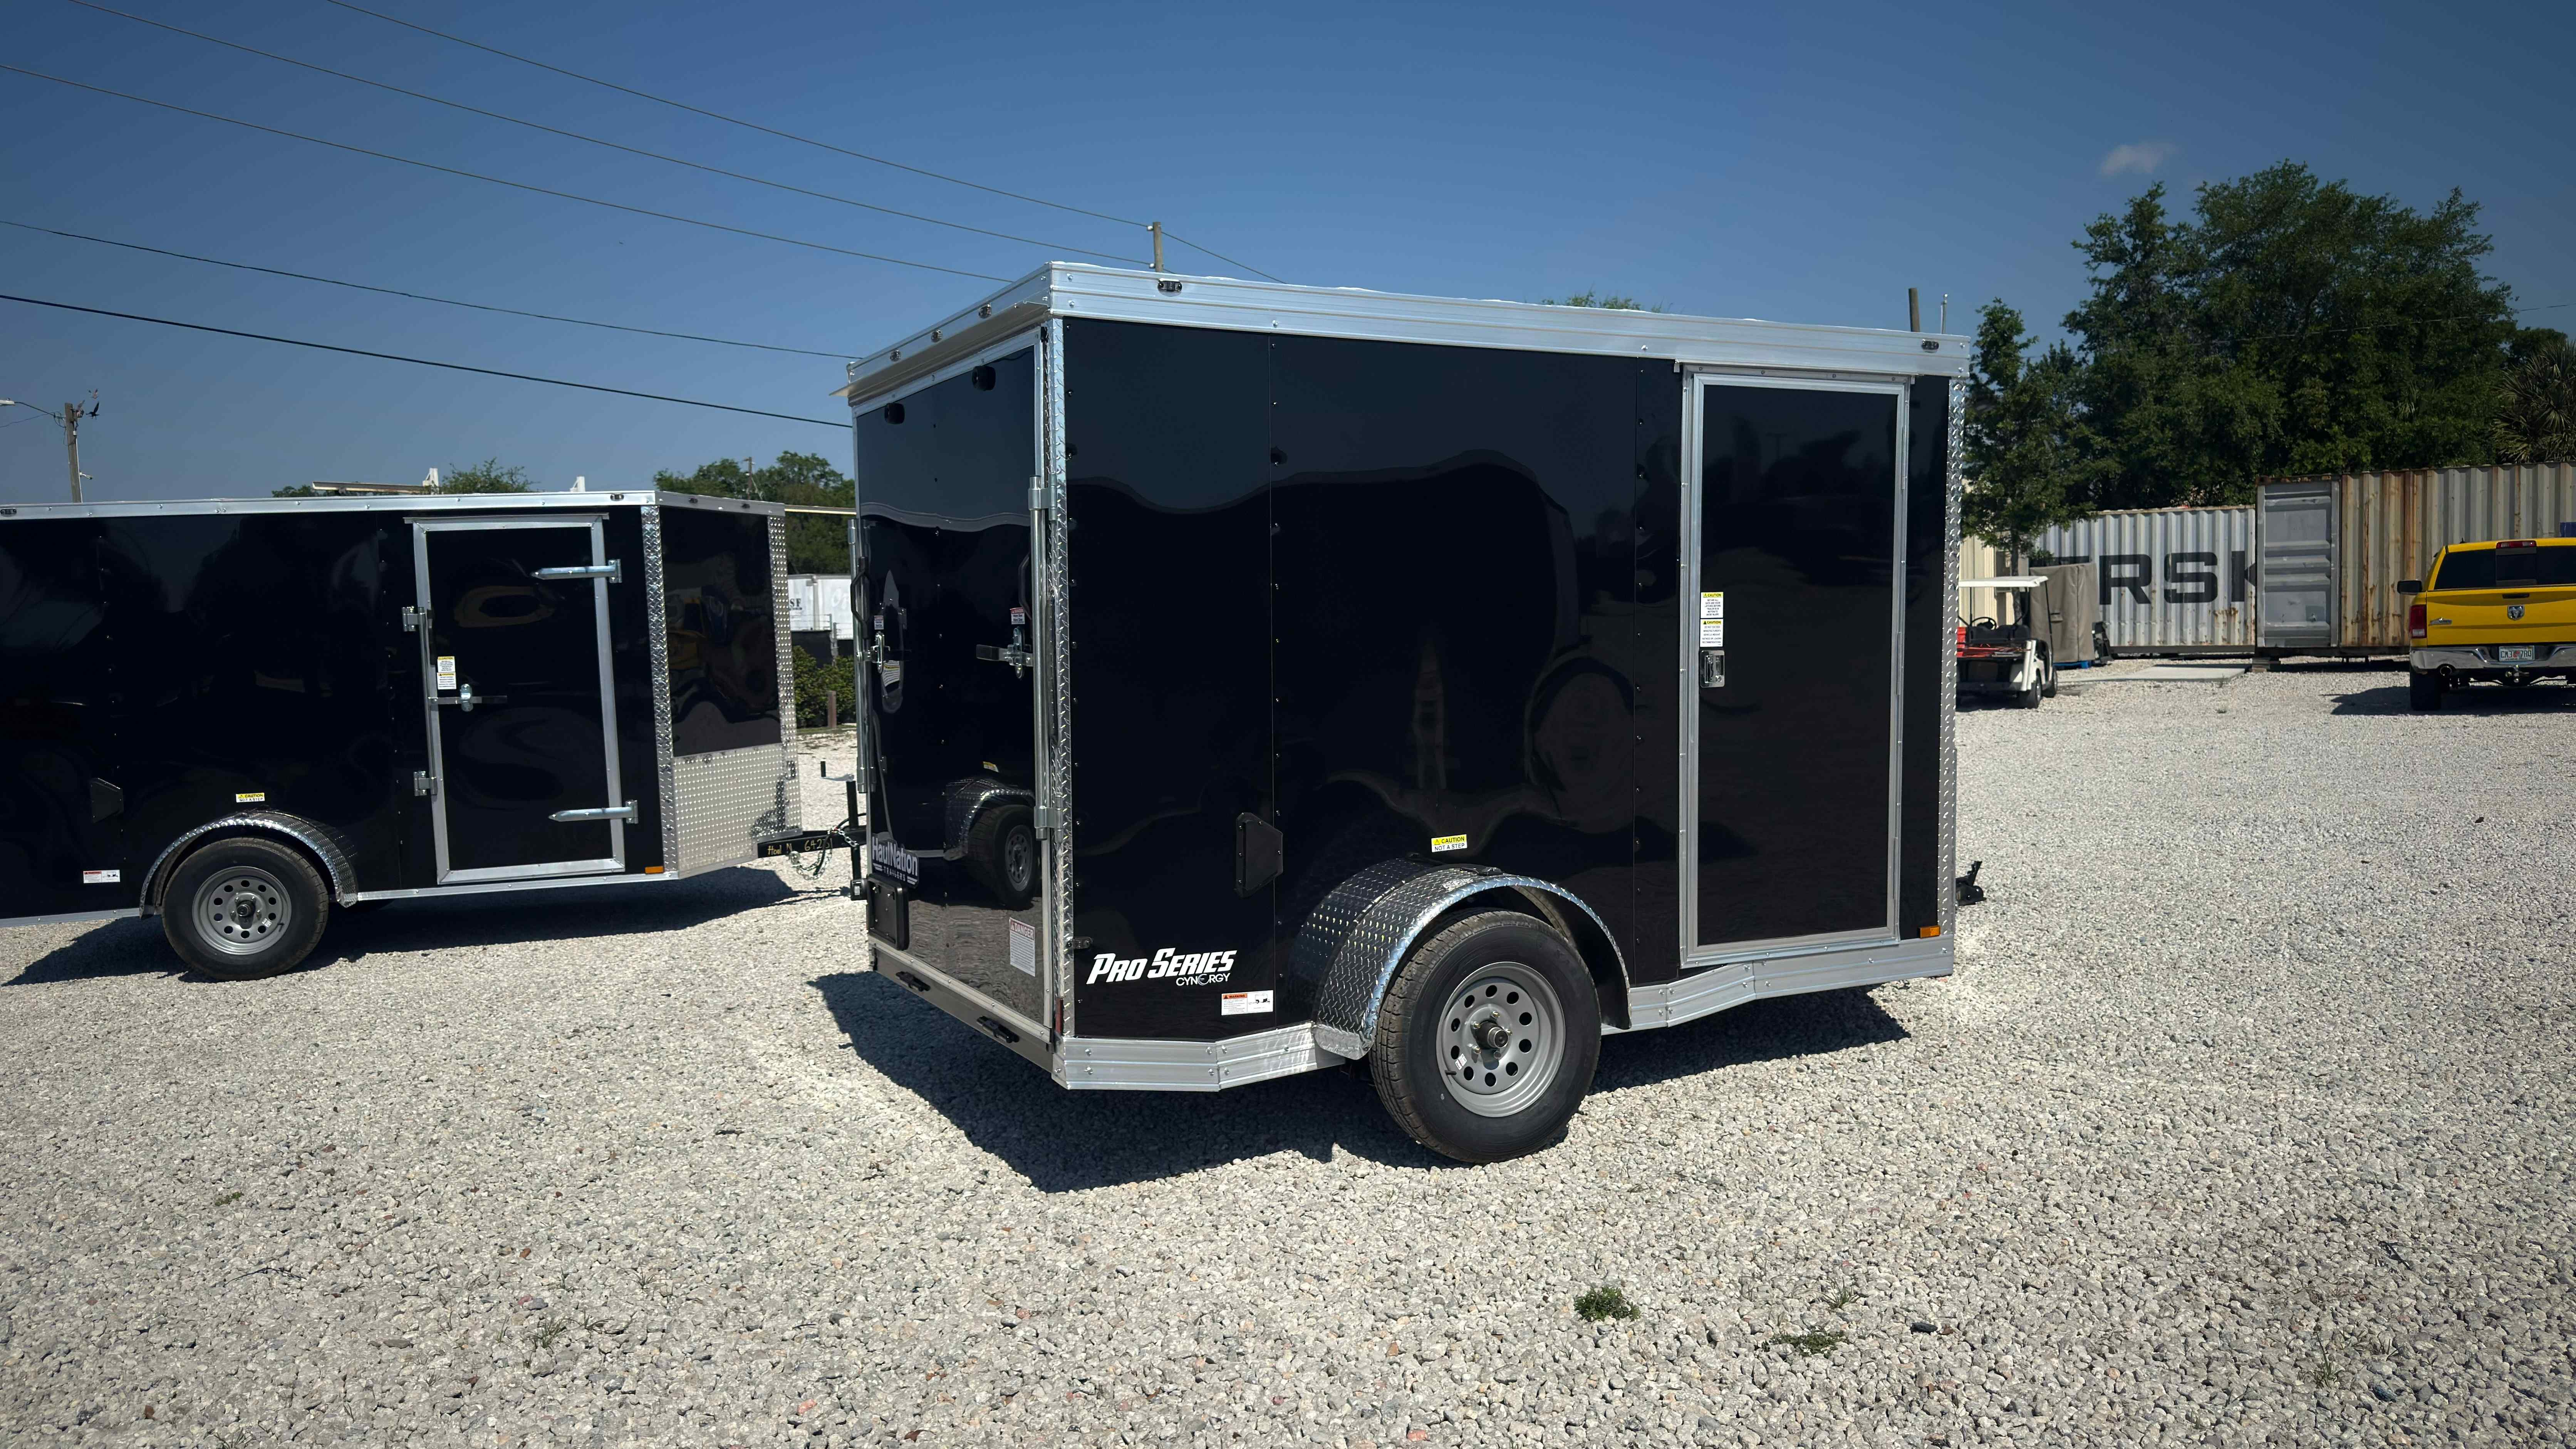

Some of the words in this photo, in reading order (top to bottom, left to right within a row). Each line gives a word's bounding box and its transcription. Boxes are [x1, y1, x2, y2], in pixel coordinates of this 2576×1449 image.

[872, 836, 917, 876] HaulNation
[884, 866, 906, 882] TRAILERS
[1014, 922, 1034, 940] DANGER
[1086, 953, 1148, 984] PRO
[1148, 947, 1237, 979] SERIES
[1176, 972, 1231, 986] CYNERGY
